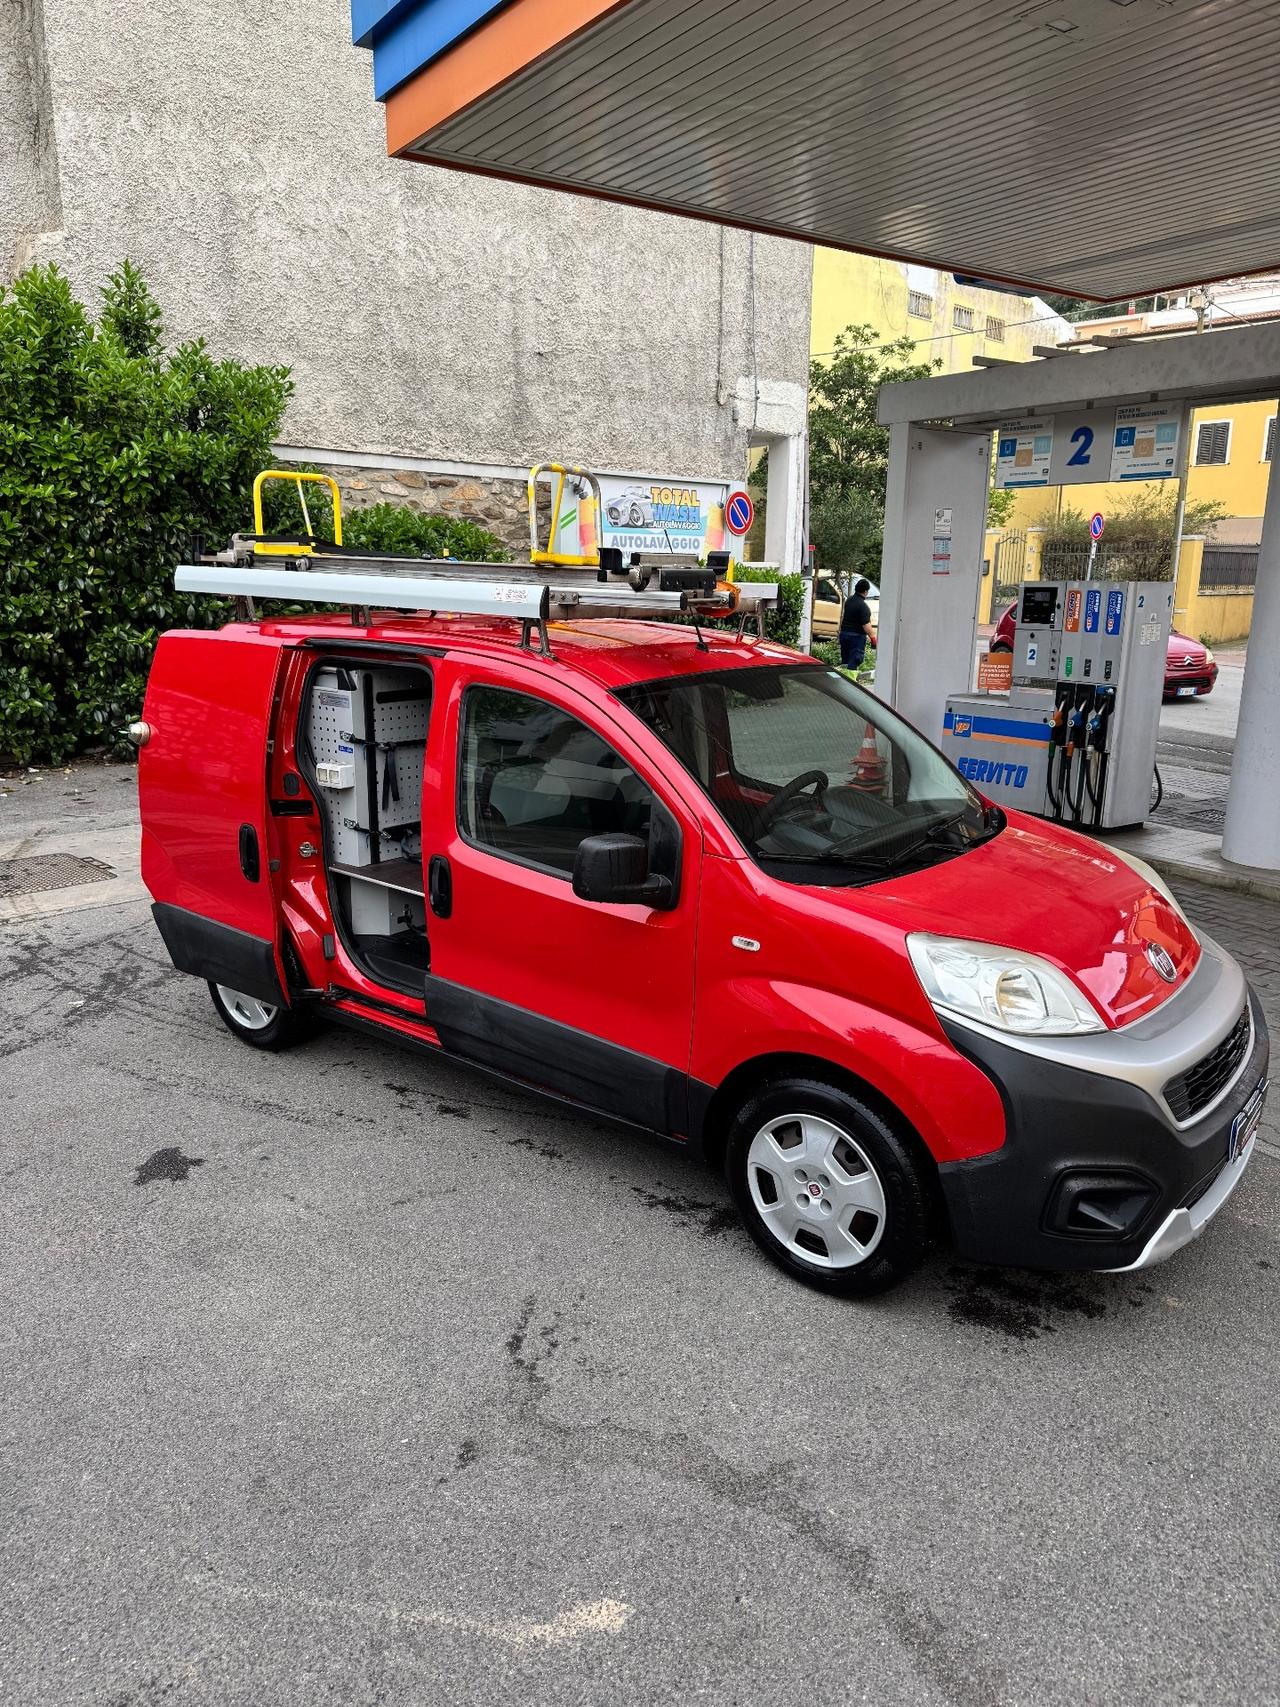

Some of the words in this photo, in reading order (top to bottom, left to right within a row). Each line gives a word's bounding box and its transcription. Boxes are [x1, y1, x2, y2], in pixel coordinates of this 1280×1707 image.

[1066, 425, 1094, 466] 2
[651, 486, 700, 507] TOTAL
[651, 503, 700, 522] WASH
[611, 534, 700, 550] AUTOLAVAGGIO
[1138, 596, 1145, 608] 2
[1167, 595, 1172, 607] 1
[1028, 648, 1036, 660] 2
[958, 757, 1029, 788] SERVITO
